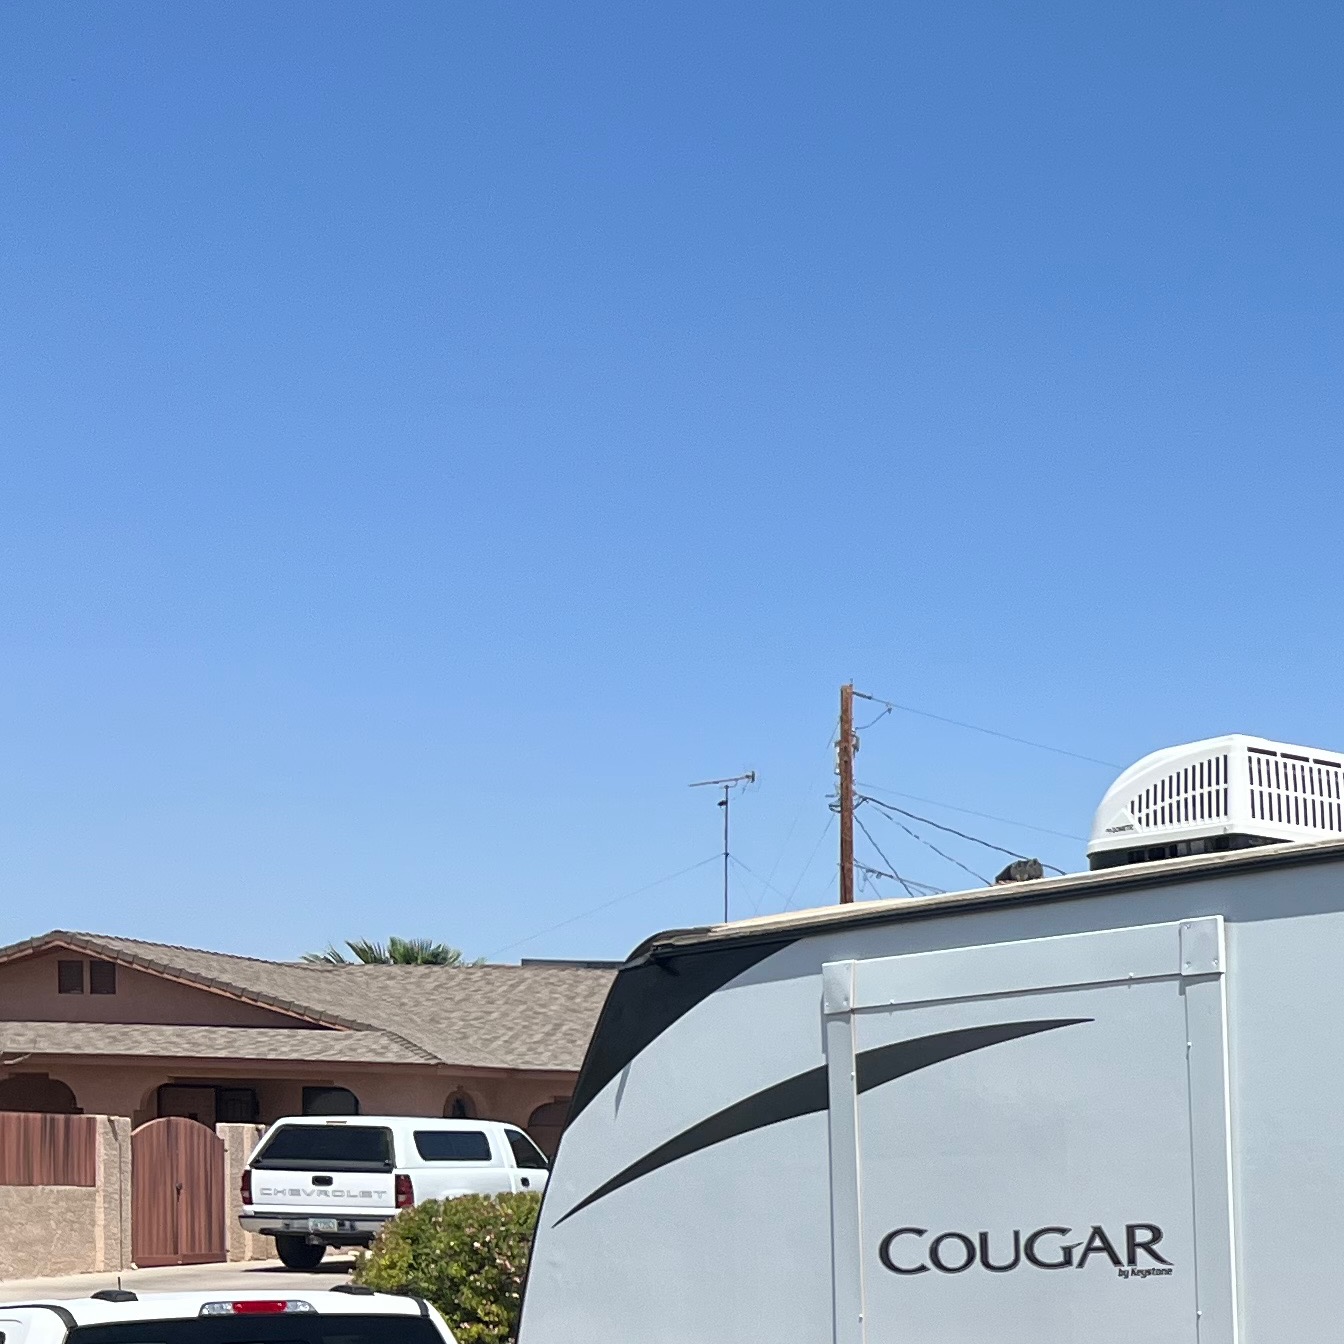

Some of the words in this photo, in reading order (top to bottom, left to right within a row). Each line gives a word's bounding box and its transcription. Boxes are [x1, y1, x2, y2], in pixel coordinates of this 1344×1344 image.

[259, 1187, 387, 1199] CHEVROLET
[878, 1222, 1175, 1276] COUGAR
[1118, 1268, 1129, 1279] by
[1131, 1267, 1173, 1278] Keystone
